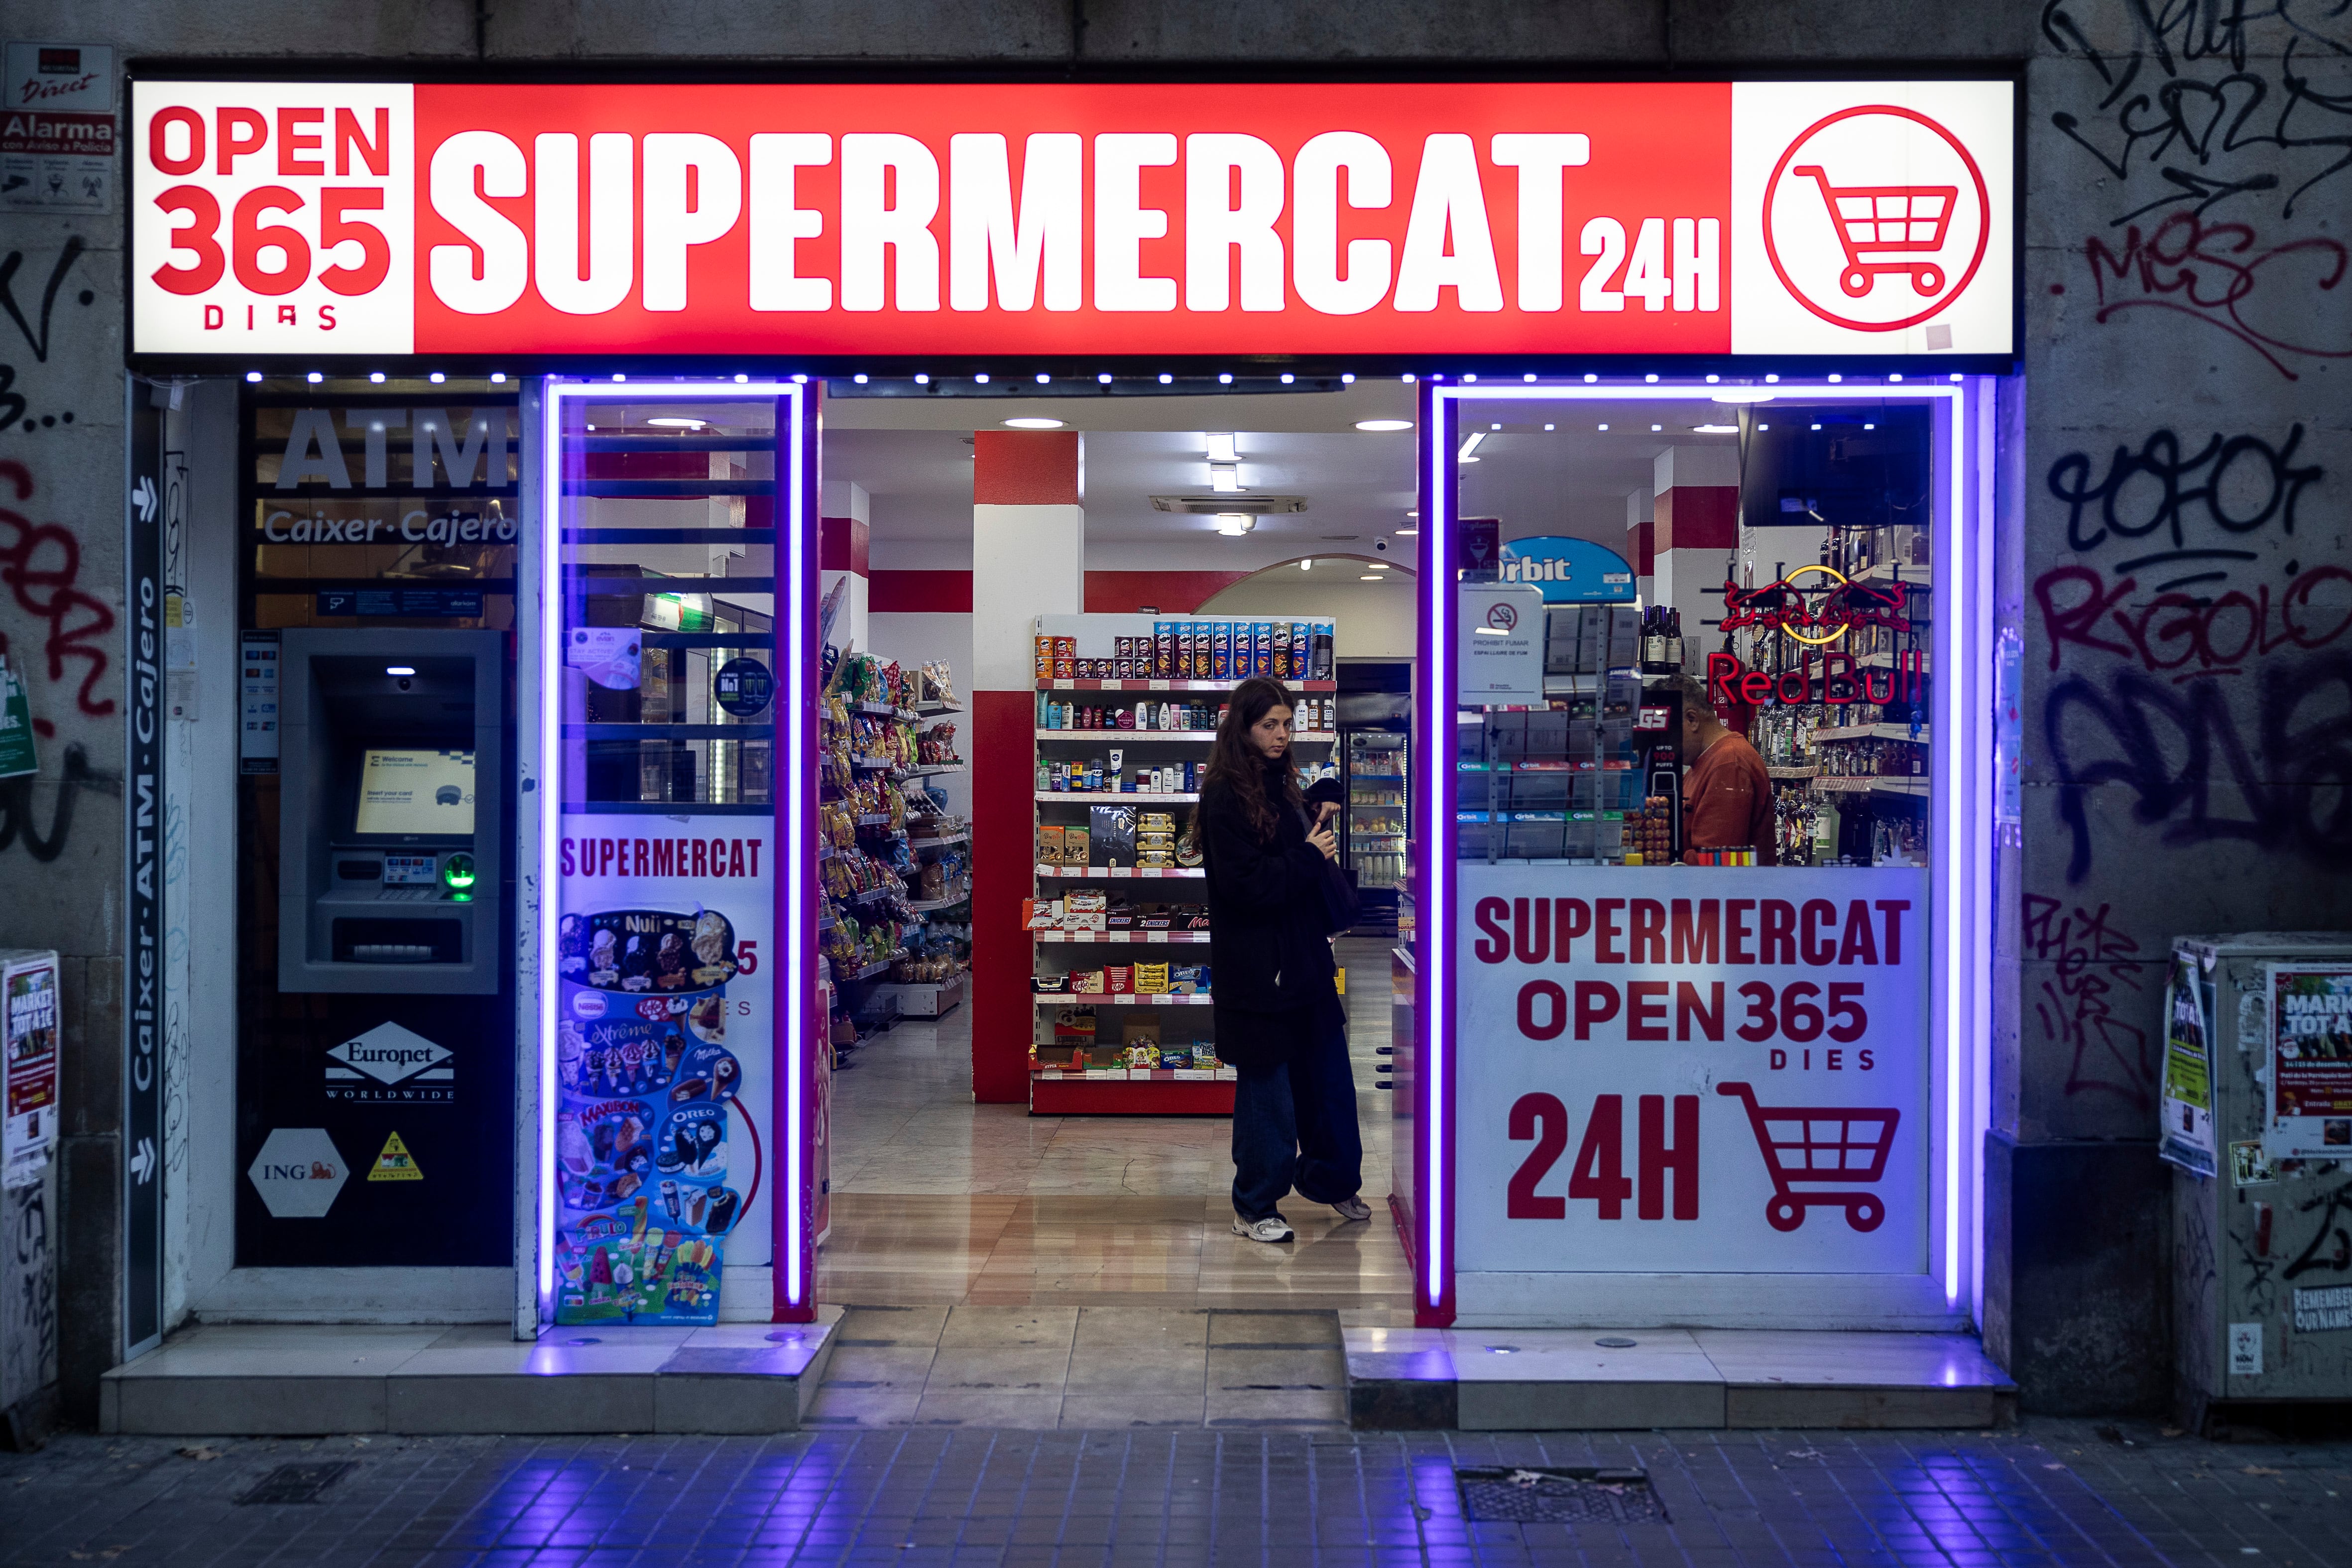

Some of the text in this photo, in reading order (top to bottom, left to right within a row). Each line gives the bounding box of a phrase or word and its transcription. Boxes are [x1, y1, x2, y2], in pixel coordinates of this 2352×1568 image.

[20, 73, 100, 104] Direct
[4, 115, 112, 140] Alarma
[149, 105, 390, 176] OPEN
[429, 129, 1721, 315] SUPERMERCAT 24H
[150, 184, 391, 296] 365
[274, 408, 508, 489] ATM
[264, 509, 518, 548] Caixer Cajero
[135, 576, 158, 744] Cajero
[1707, 648, 1922, 705] Red Bull
[1519, 761, 1540, 770] Orbit
[1653, 752, 1675, 761] 900
[1515, 812, 1535, 821] Orbit
[136, 774, 153, 899] ATM
[561, 838, 762, 877] SUPERMERCAT
[1187, 916, 1210, 929] Ma
[1474, 896, 1911, 966] SUPERMERCAT
[1072, 980, 1088, 991] KitKat
[133, 929, 153, 1091] Caixer
[1517, 978, 1868, 1043] OPEN 365
[2287, 994, 2352, 1014] MARK
[2286, 1015, 2352, 1034] TOT A
[347, 1042, 433, 1064] Euronet
[1770, 1048, 1875, 1071] DIES
[326, 1090, 455, 1099] WORLDWIDE
[579, 1099, 640, 1129] MAXIBON
[672, 1109, 715, 1123] OREO
[1507, 1091, 1699, 1220] 24H
[264, 1165, 305, 1180] ING
